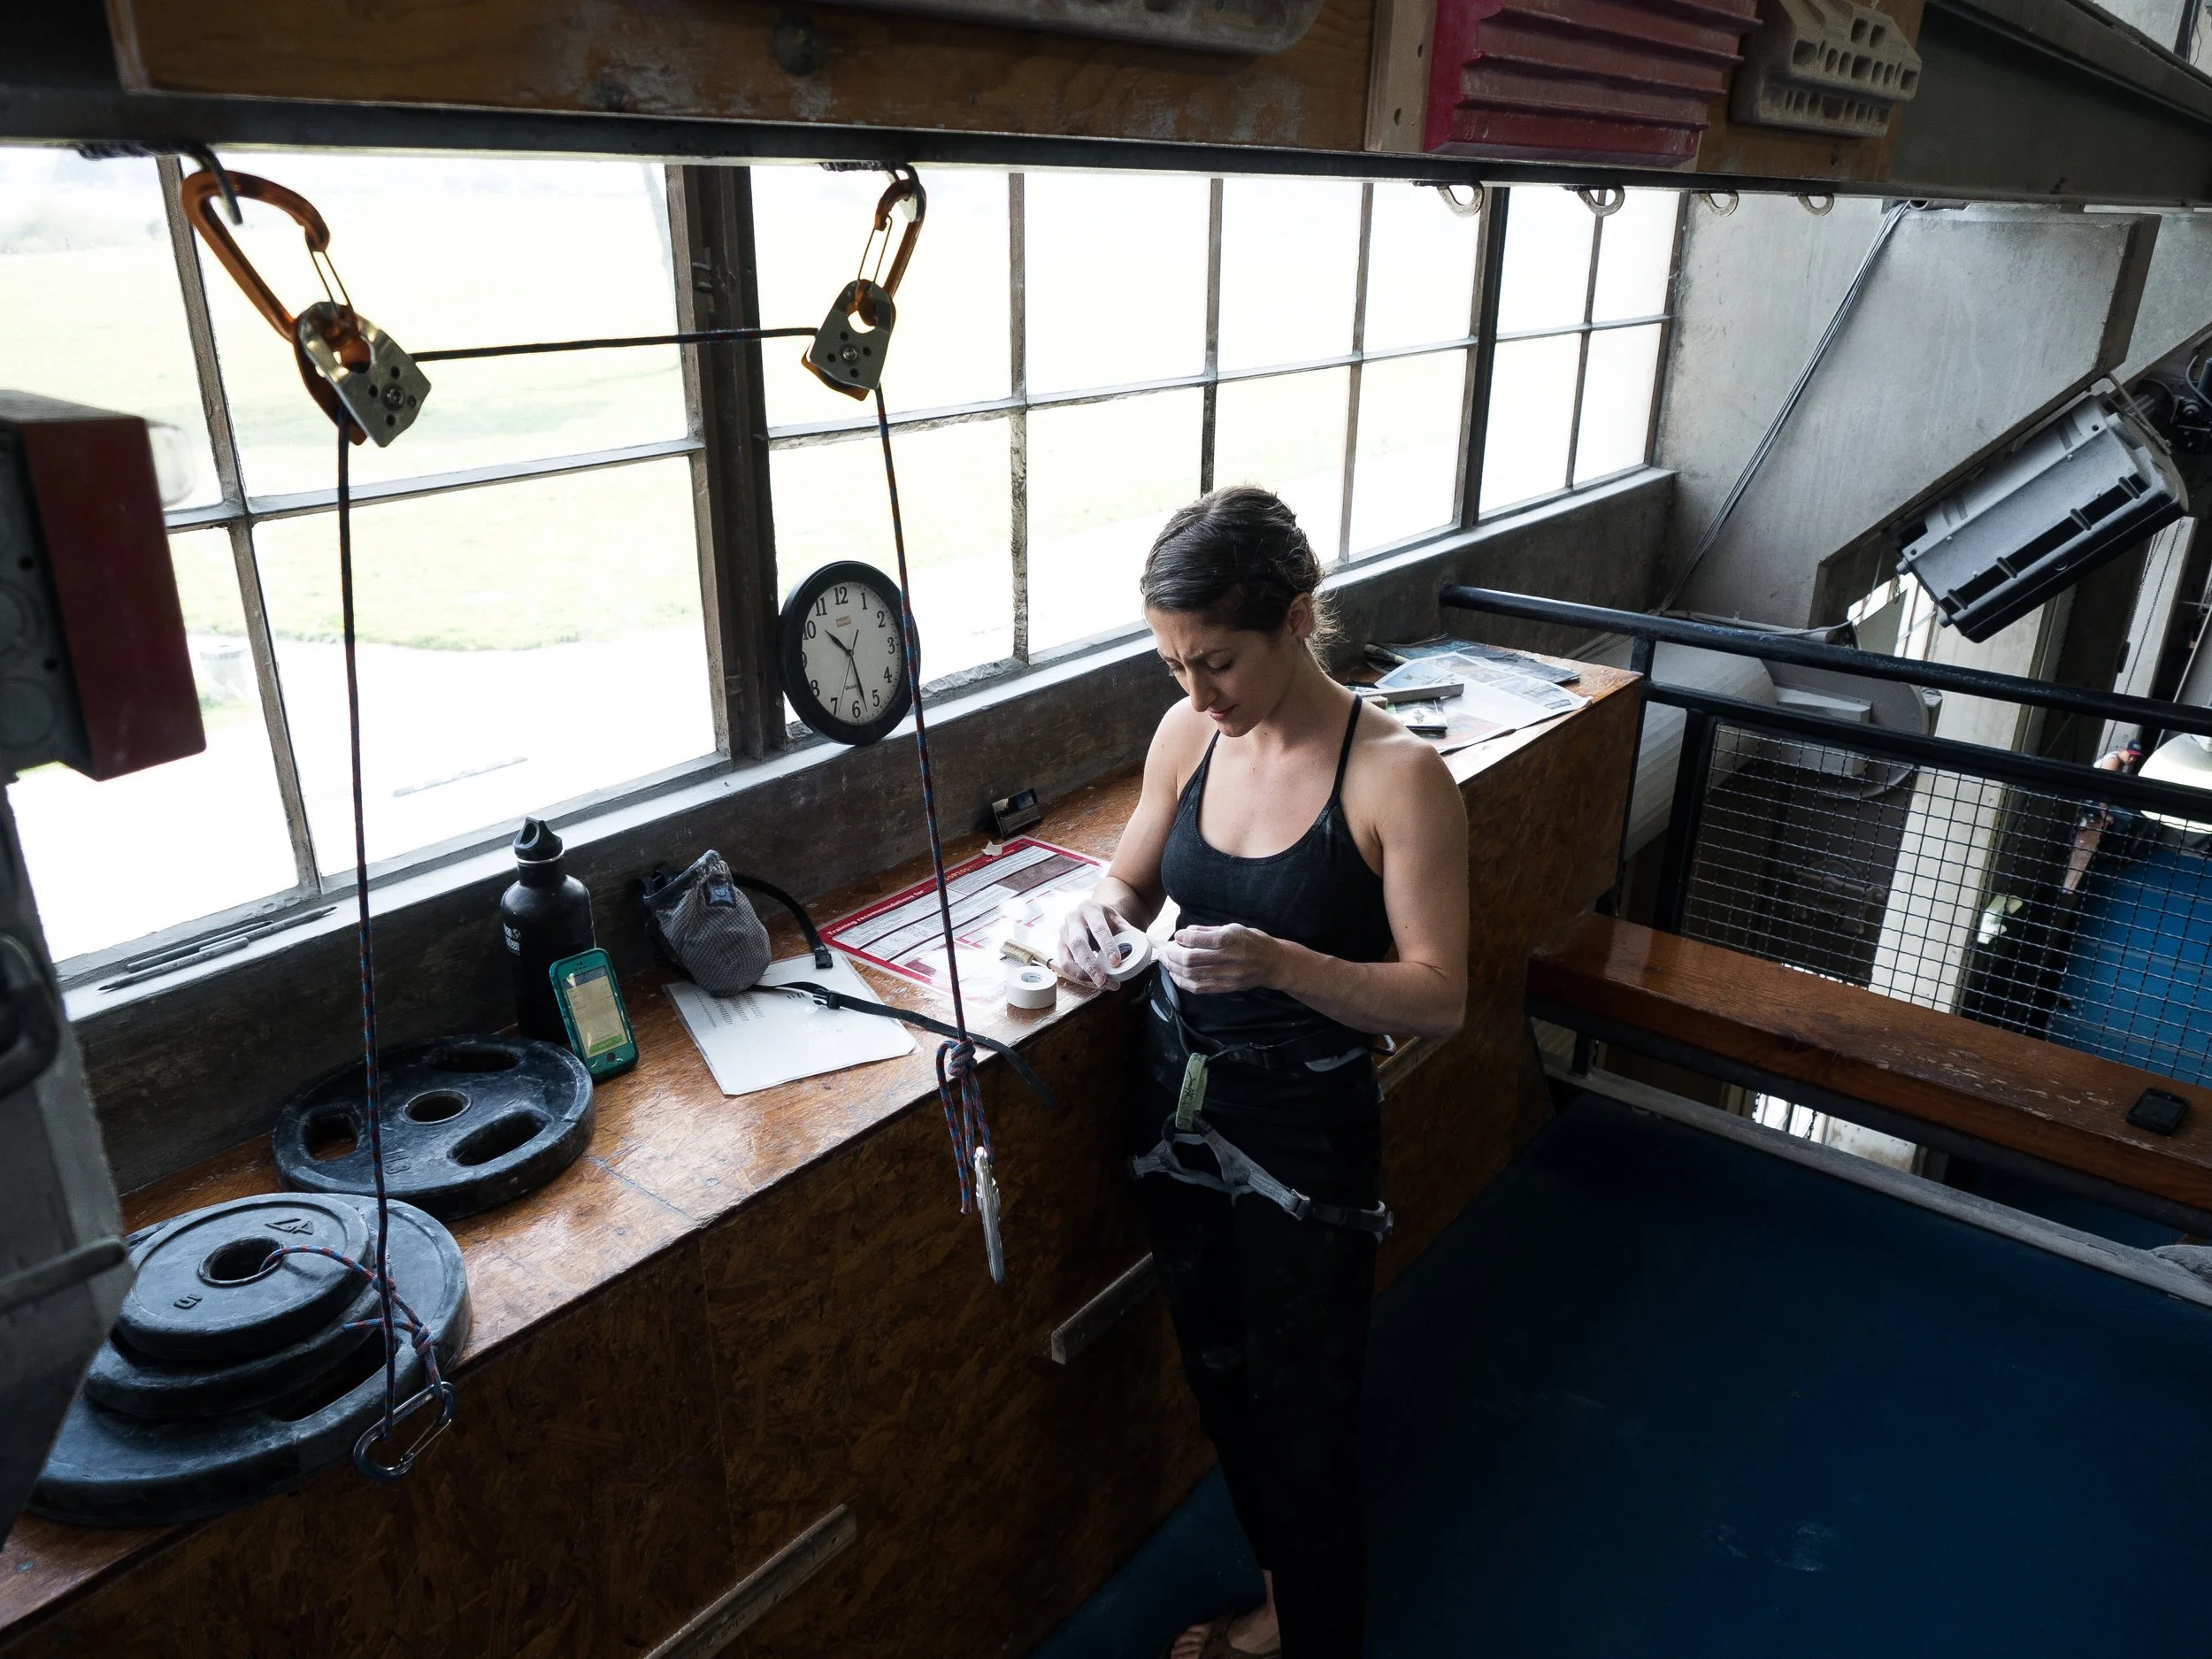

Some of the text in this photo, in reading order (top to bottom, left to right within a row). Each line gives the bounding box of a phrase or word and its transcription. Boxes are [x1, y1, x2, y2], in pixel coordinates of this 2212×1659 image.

[833, 587, 849, 605] 12
[860, 592, 868, 611] 1
[815, 597, 828, 617] 11
[876, 611, 886, 628] 2
[803, 620, 817, 641] 10
[887, 637, 895, 655] 3
[883, 666, 892, 683] 4
[810, 680, 820, 697] 8
[830, 697, 839, 715] 7
[872, 689, 880, 707] 5
[851, 700, 862, 718] 6
[826, 920, 857, 936] Training
[856, 895, 915, 922] recommendations
